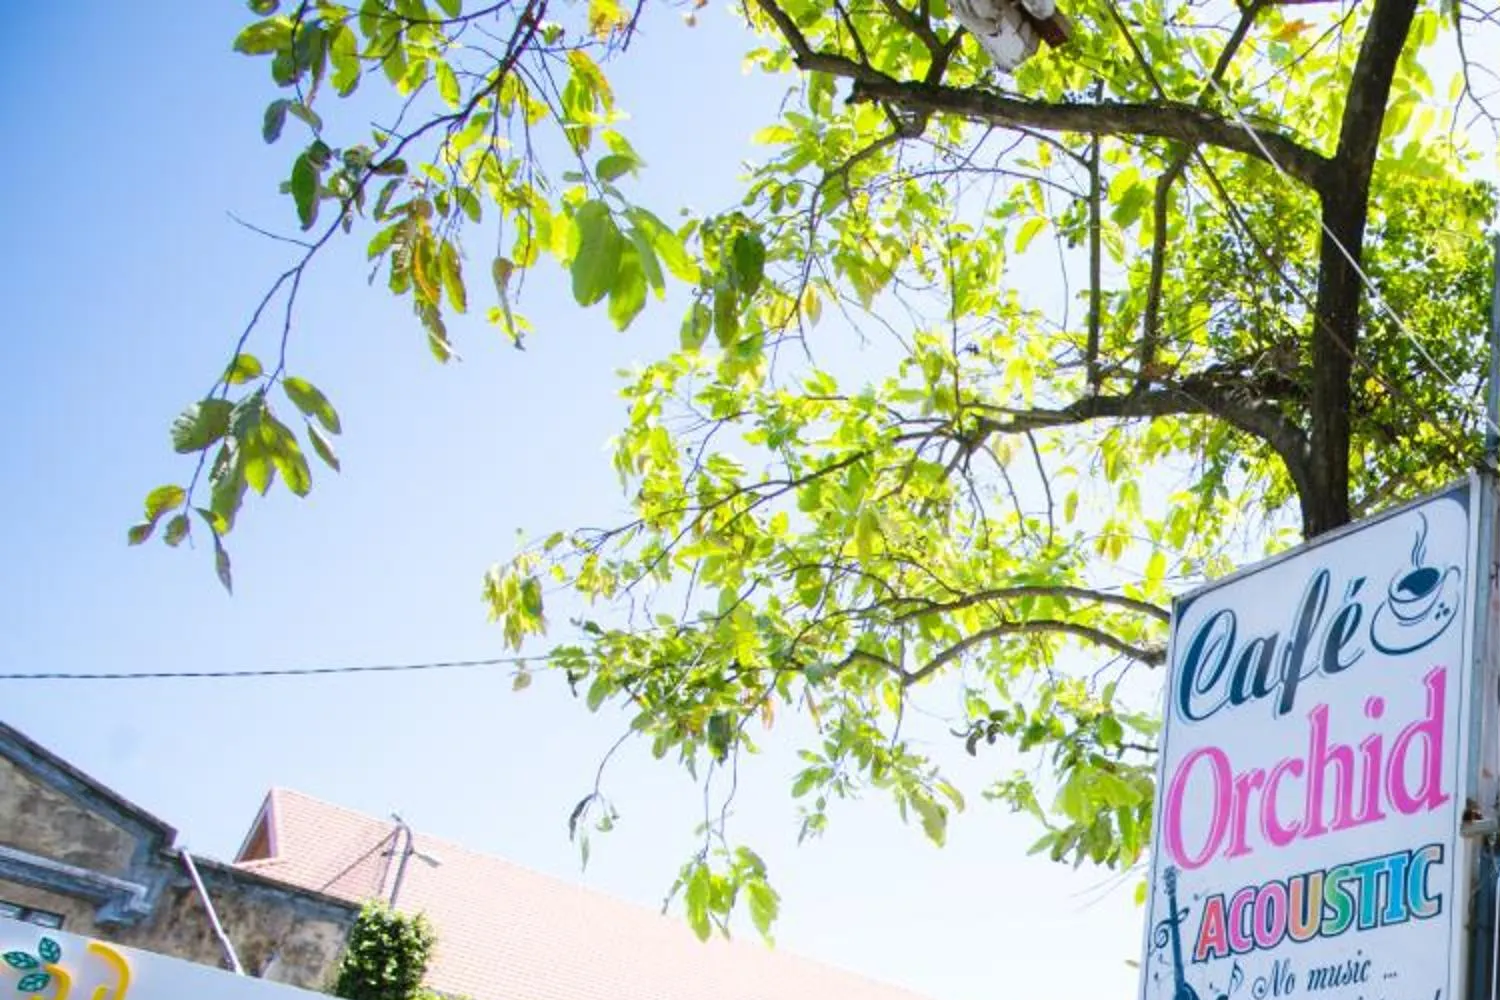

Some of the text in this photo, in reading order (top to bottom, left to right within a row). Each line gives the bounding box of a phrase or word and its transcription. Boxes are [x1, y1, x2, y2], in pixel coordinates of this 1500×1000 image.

[1178, 568, 1368, 722] Café
[1166, 666, 1448, 869] Orchid
[1192, 845, 1444, 963] ACOUSTIC
[1252, 957, 1296, 1000] No
[1307, 950, 1372, 991] music
